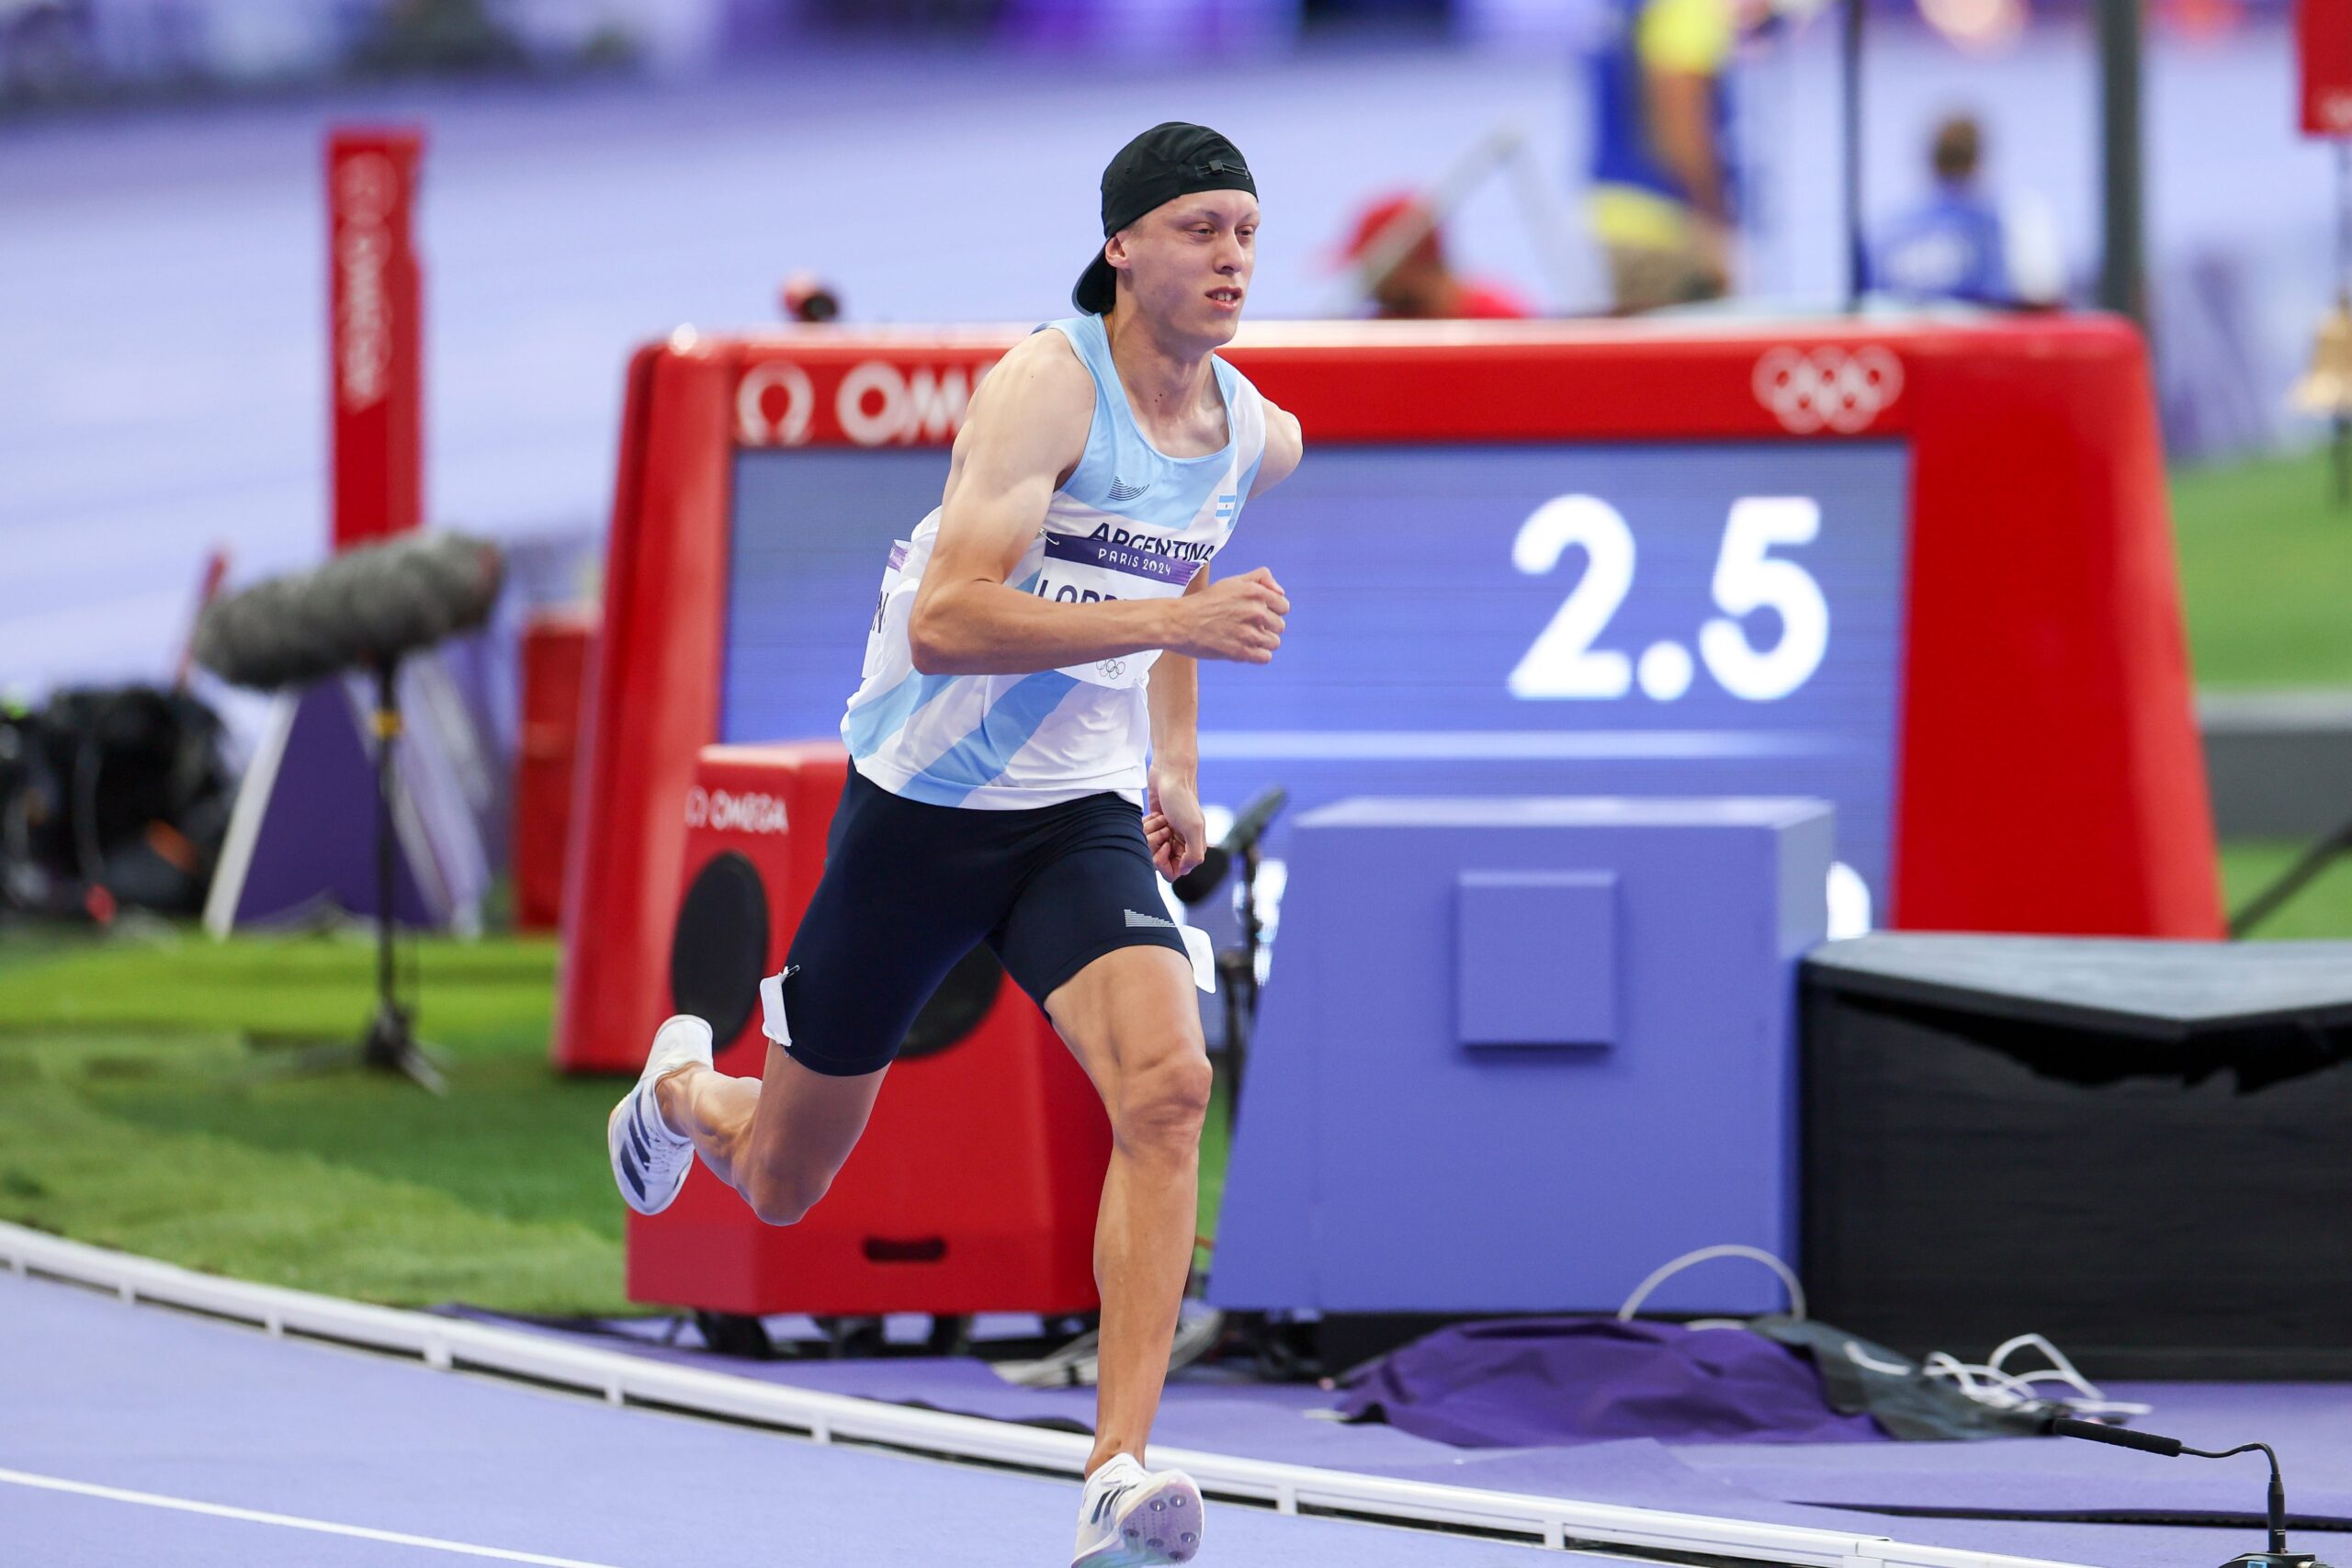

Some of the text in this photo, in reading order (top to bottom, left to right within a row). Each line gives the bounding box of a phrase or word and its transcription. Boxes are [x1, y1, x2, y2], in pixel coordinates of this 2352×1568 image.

[1087, 522, 1216, 562] ARGENTINA
[1142, 558, 1171, 576] 2024
[1507, 492, 1830, 703] 2.5
